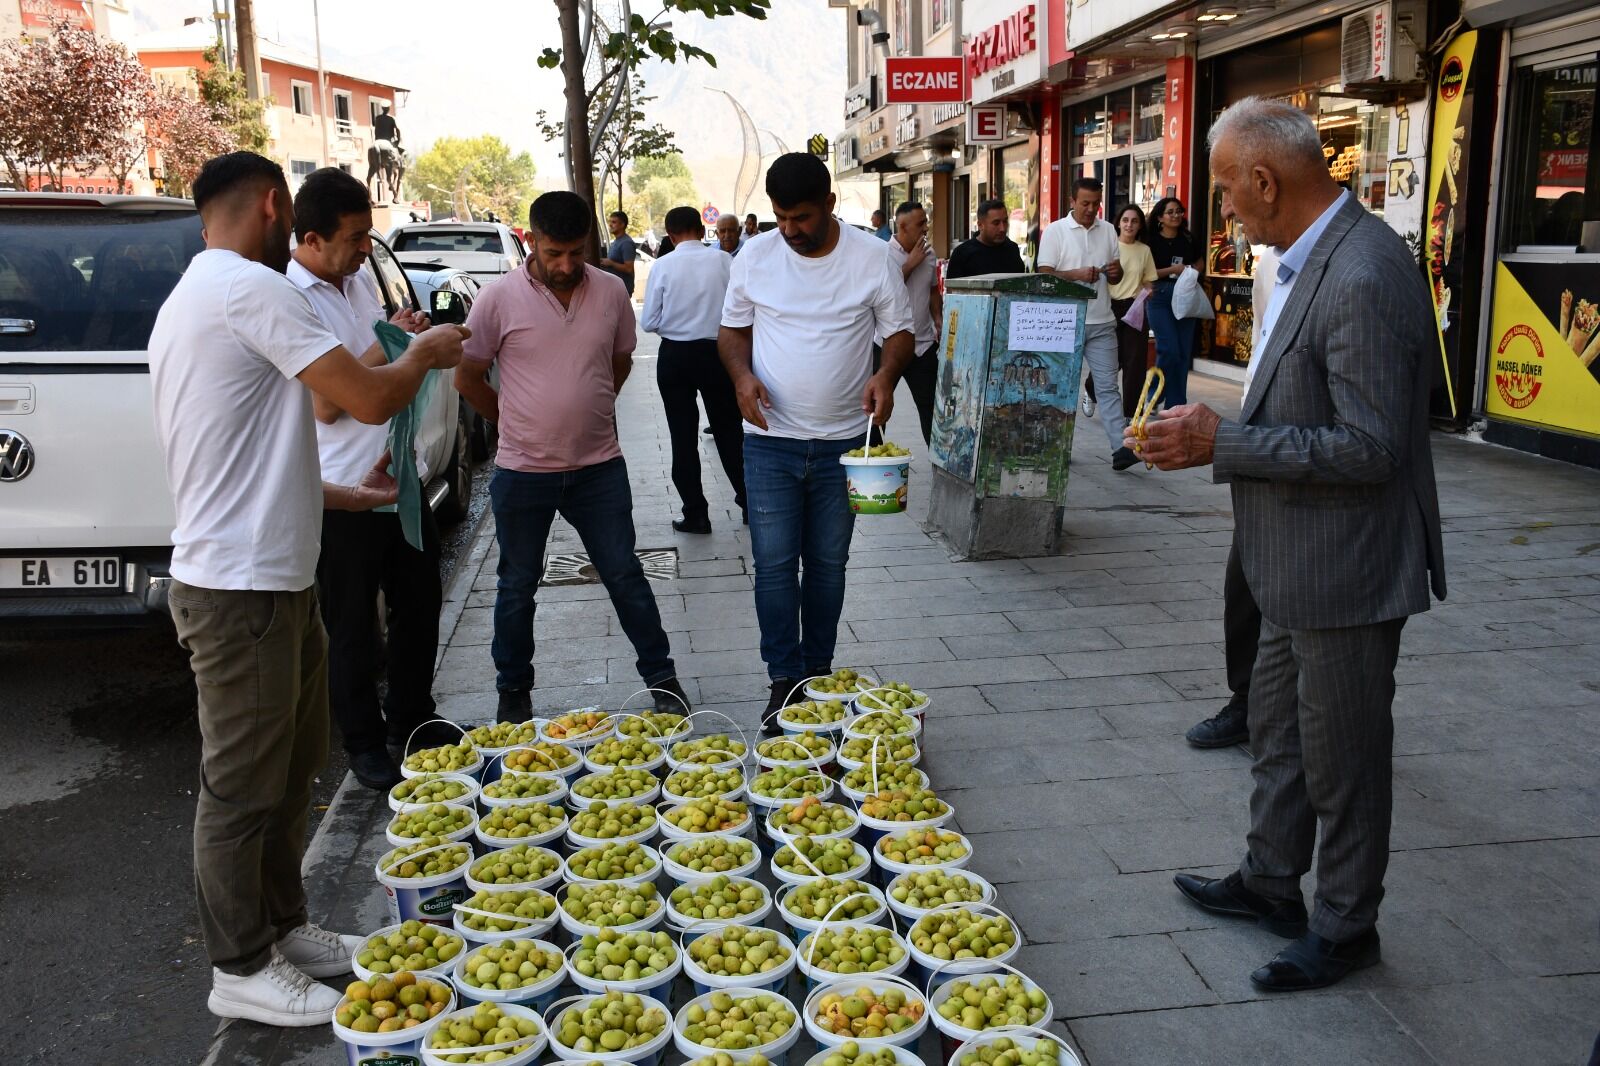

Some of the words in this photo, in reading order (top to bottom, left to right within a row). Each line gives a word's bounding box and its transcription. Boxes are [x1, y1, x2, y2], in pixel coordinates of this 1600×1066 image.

[963, 5, 1036, 78] ECZANE
[1374, 7, 1384, 76] VESTEL
[892, 72, 958, 90] ECZANE
[978, 111, 997, 135] E
[1496, 359, 1519, 374] HASSEL
[1521, 361, 1543, 377] DÖNER
[22, 560, 50, 585] EA
[74, 559, 117, 585] 610
